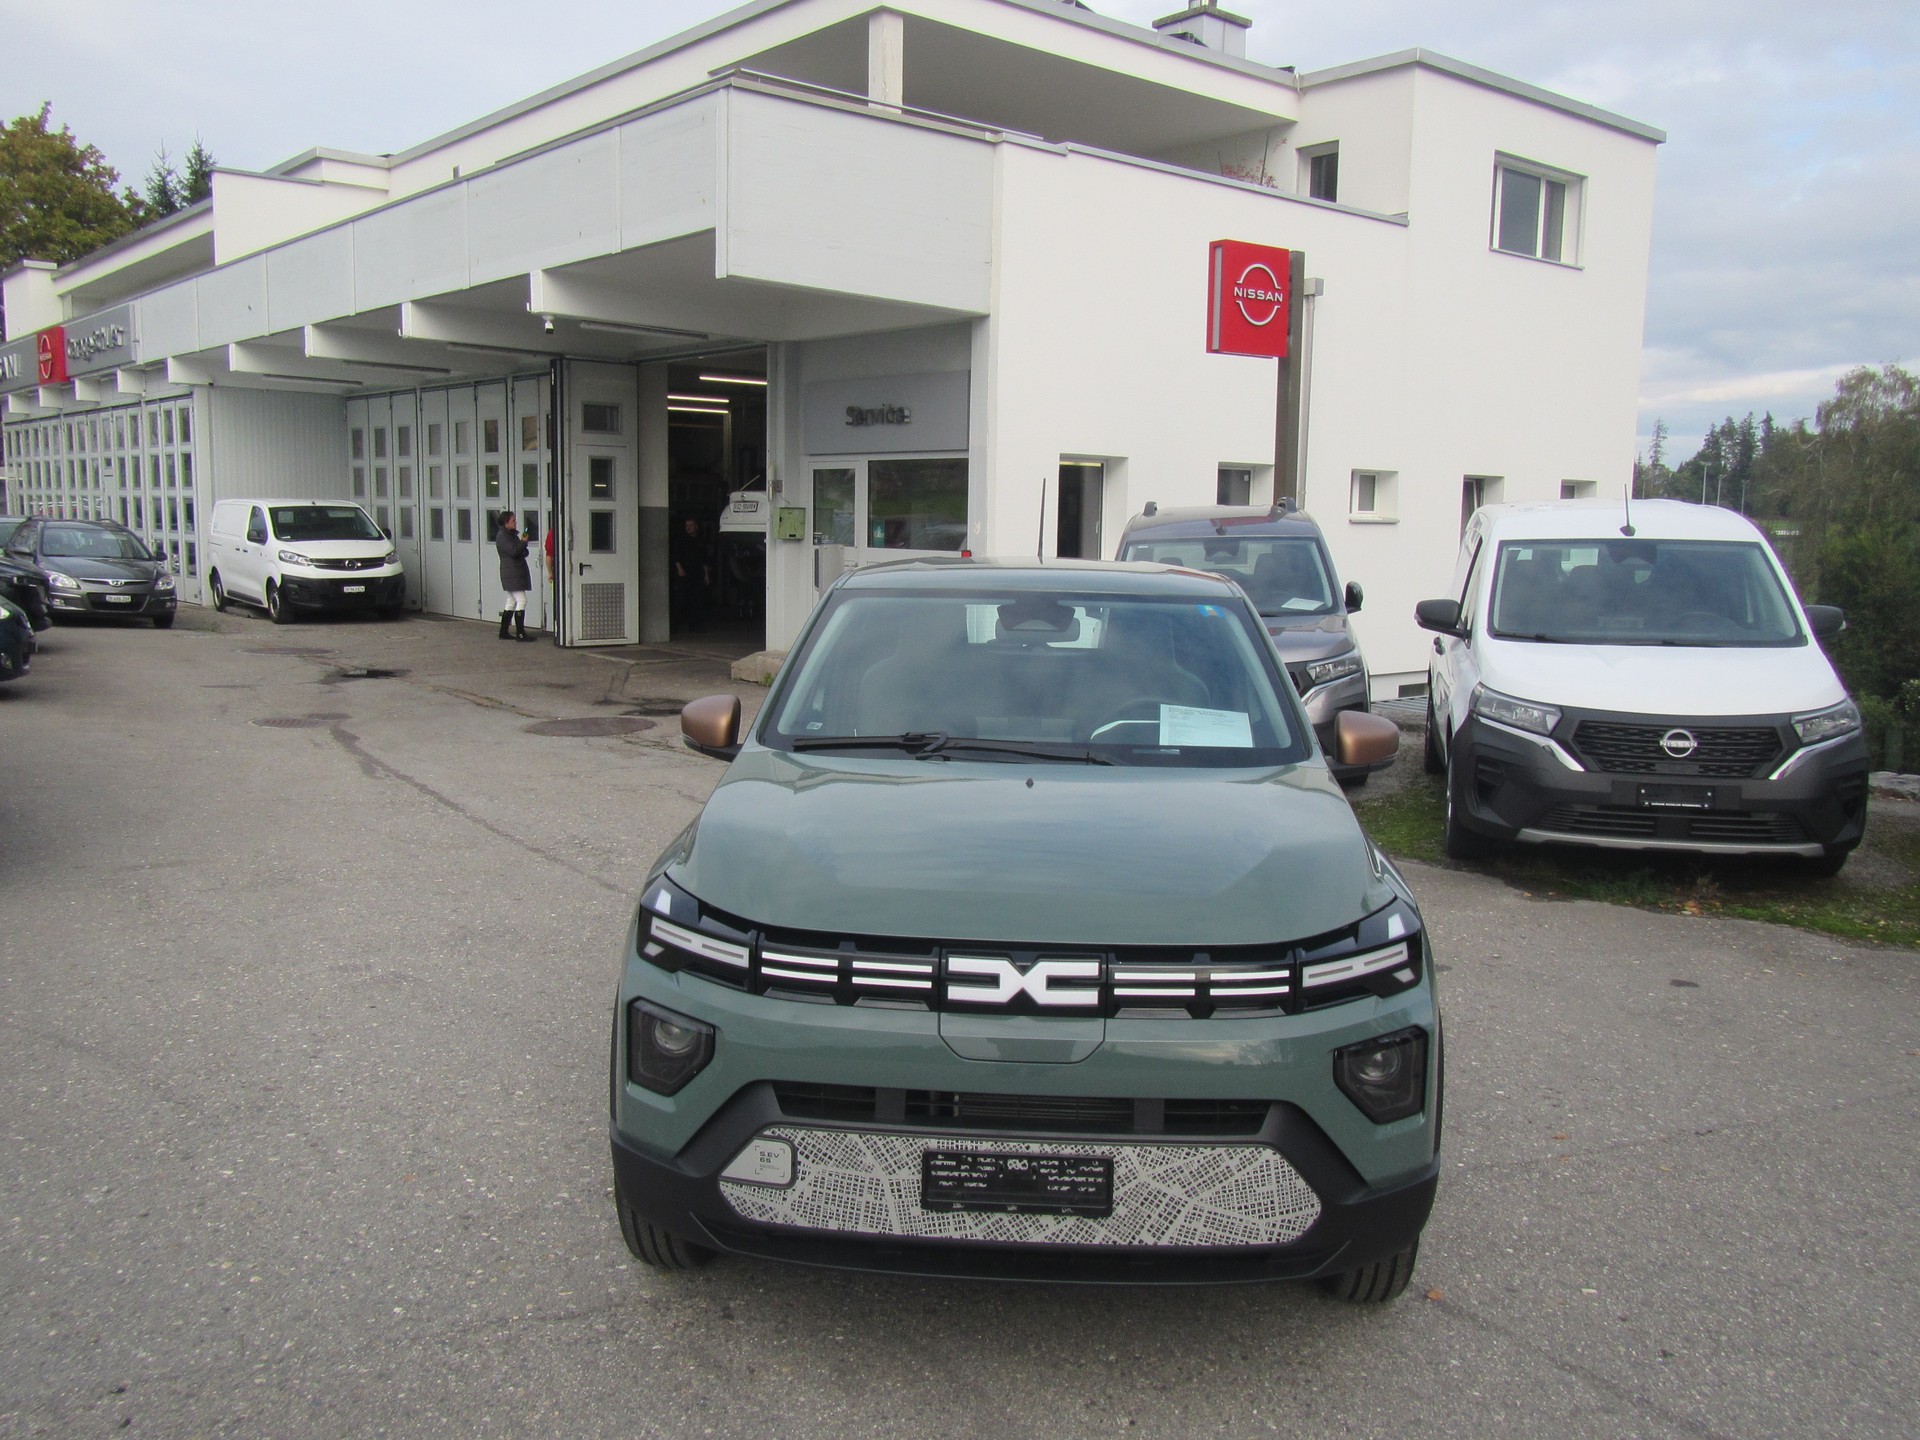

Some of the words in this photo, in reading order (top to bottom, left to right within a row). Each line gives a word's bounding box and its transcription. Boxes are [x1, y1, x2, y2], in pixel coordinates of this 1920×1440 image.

[1234, 287, 1283, 302] NISSAN
[845, 403, 911, 426] Service
[1660, 740, 1697, 748] NISSAN
